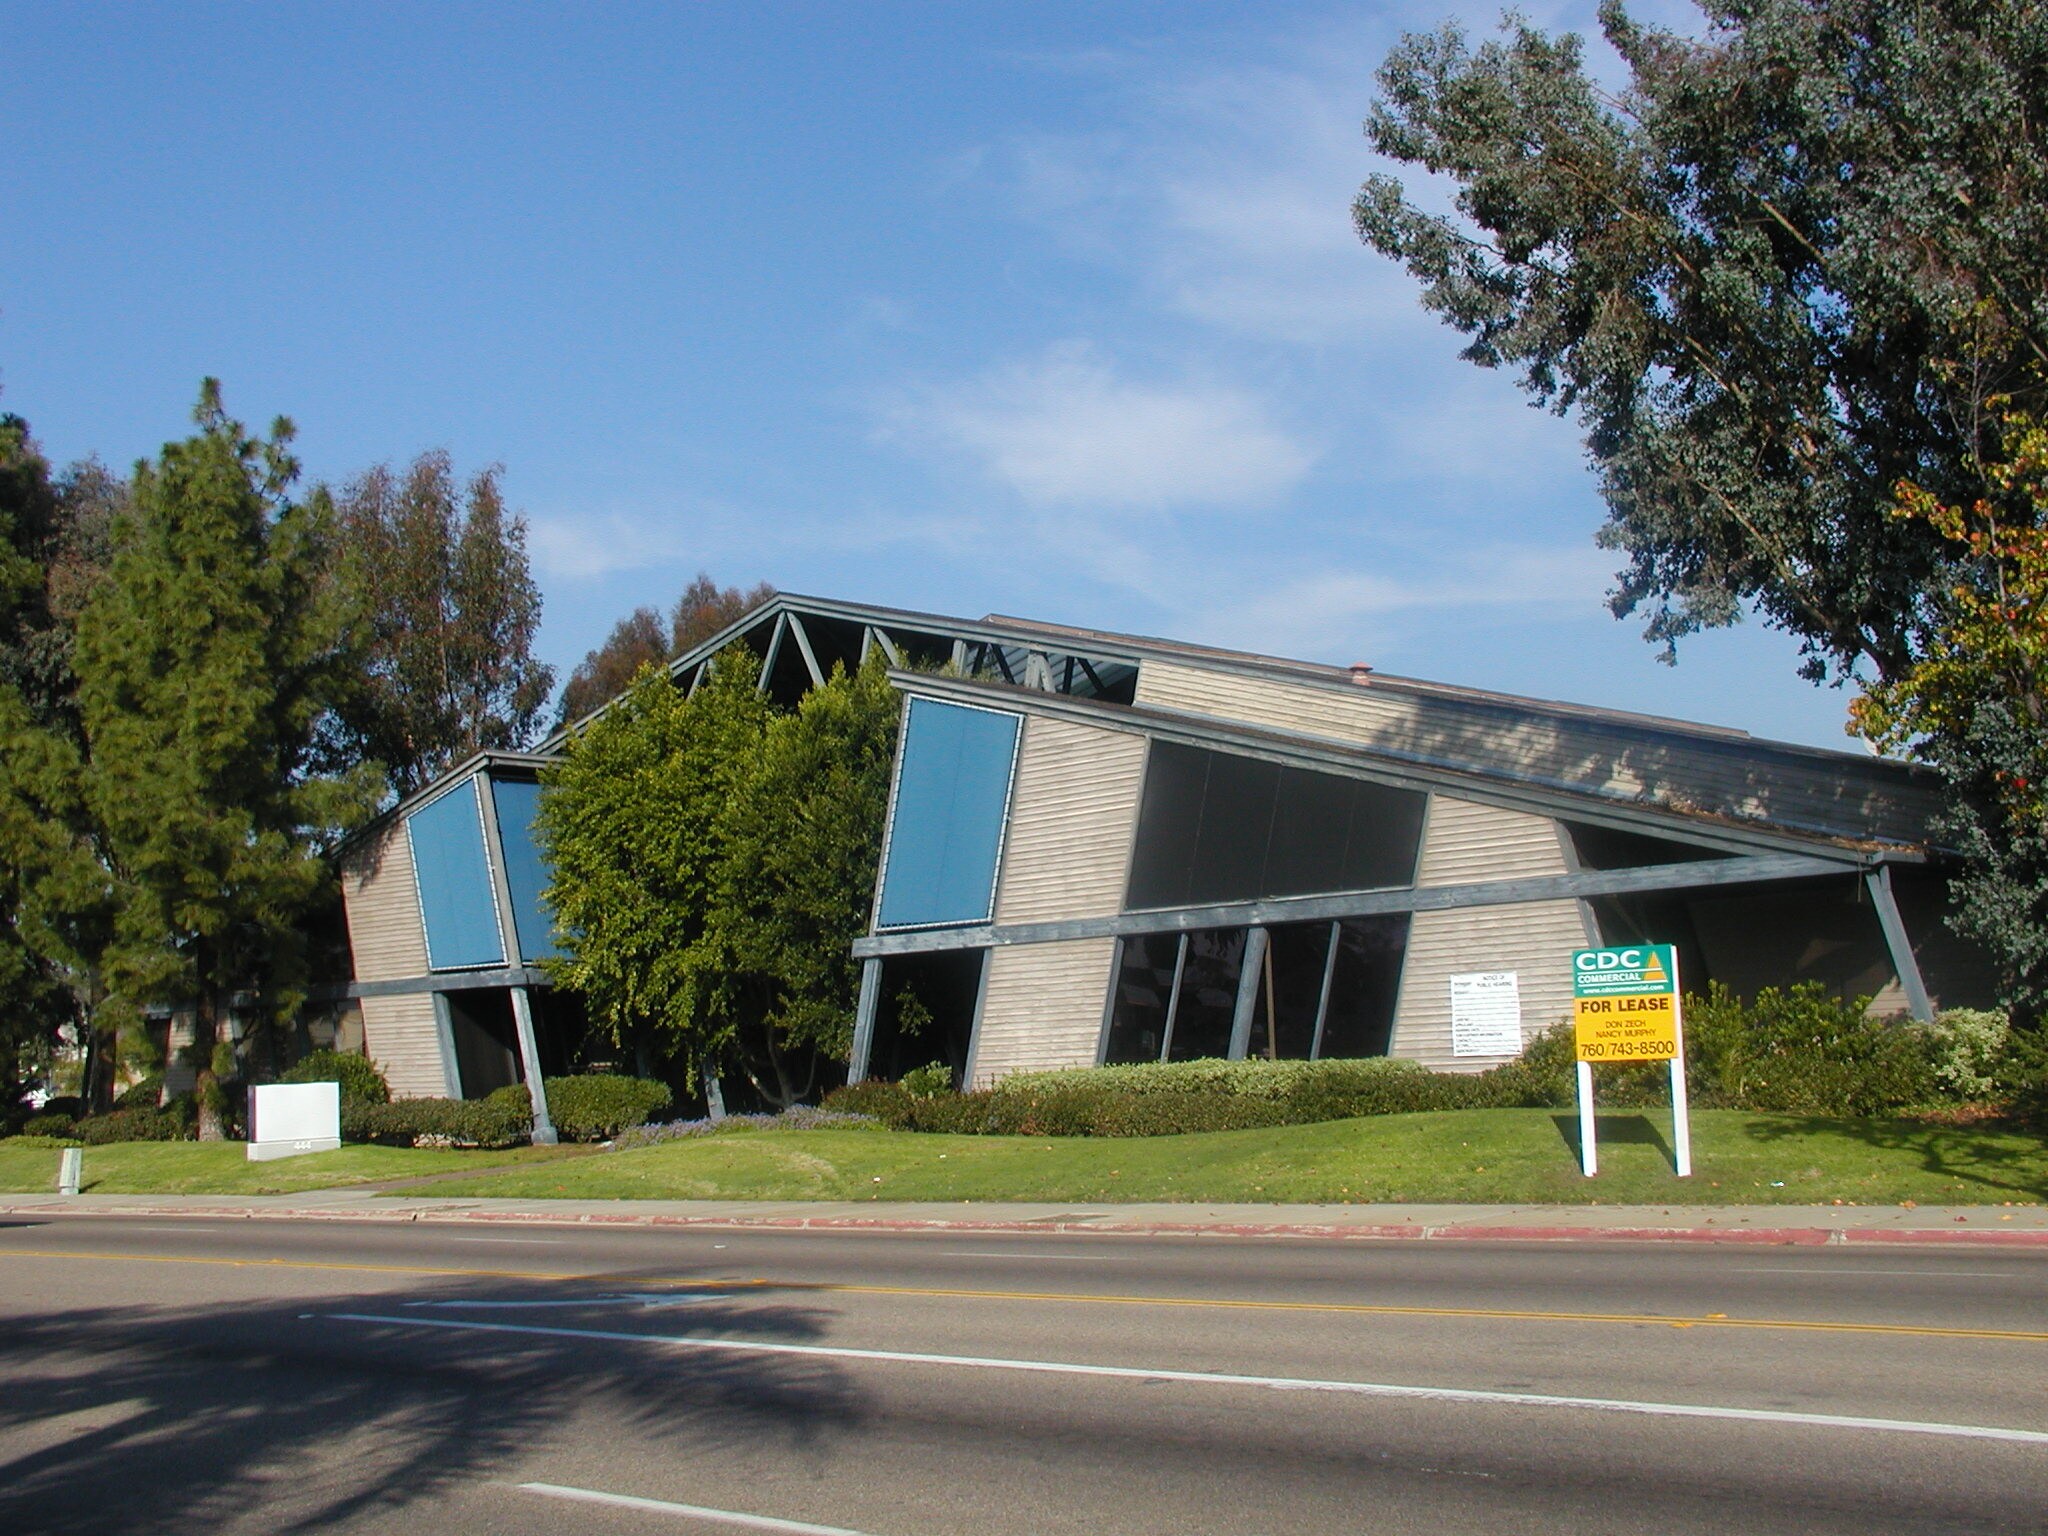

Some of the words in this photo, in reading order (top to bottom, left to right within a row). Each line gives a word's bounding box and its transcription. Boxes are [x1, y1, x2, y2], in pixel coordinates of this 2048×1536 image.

[1576, 950, 1640, 971] CDC
[1577, 972, 1641, 984] COMMERCIAL
[1583, 985, 1664, 994] www.cdccommercial.com
[1581, 1000, 1611, 1013] FOR
[1618, 998, 1669, 1011] LEASE
[1606, 1020, 1622, 1028] DON
[1624, 1020, 1646, 1028] ZECH
[1596, 1030, 1622, 1038] NANCY
[1624, 1029, 1657, 1038] MURPHY
[1581, 1041, 1674, 1057] 760/743-8500
